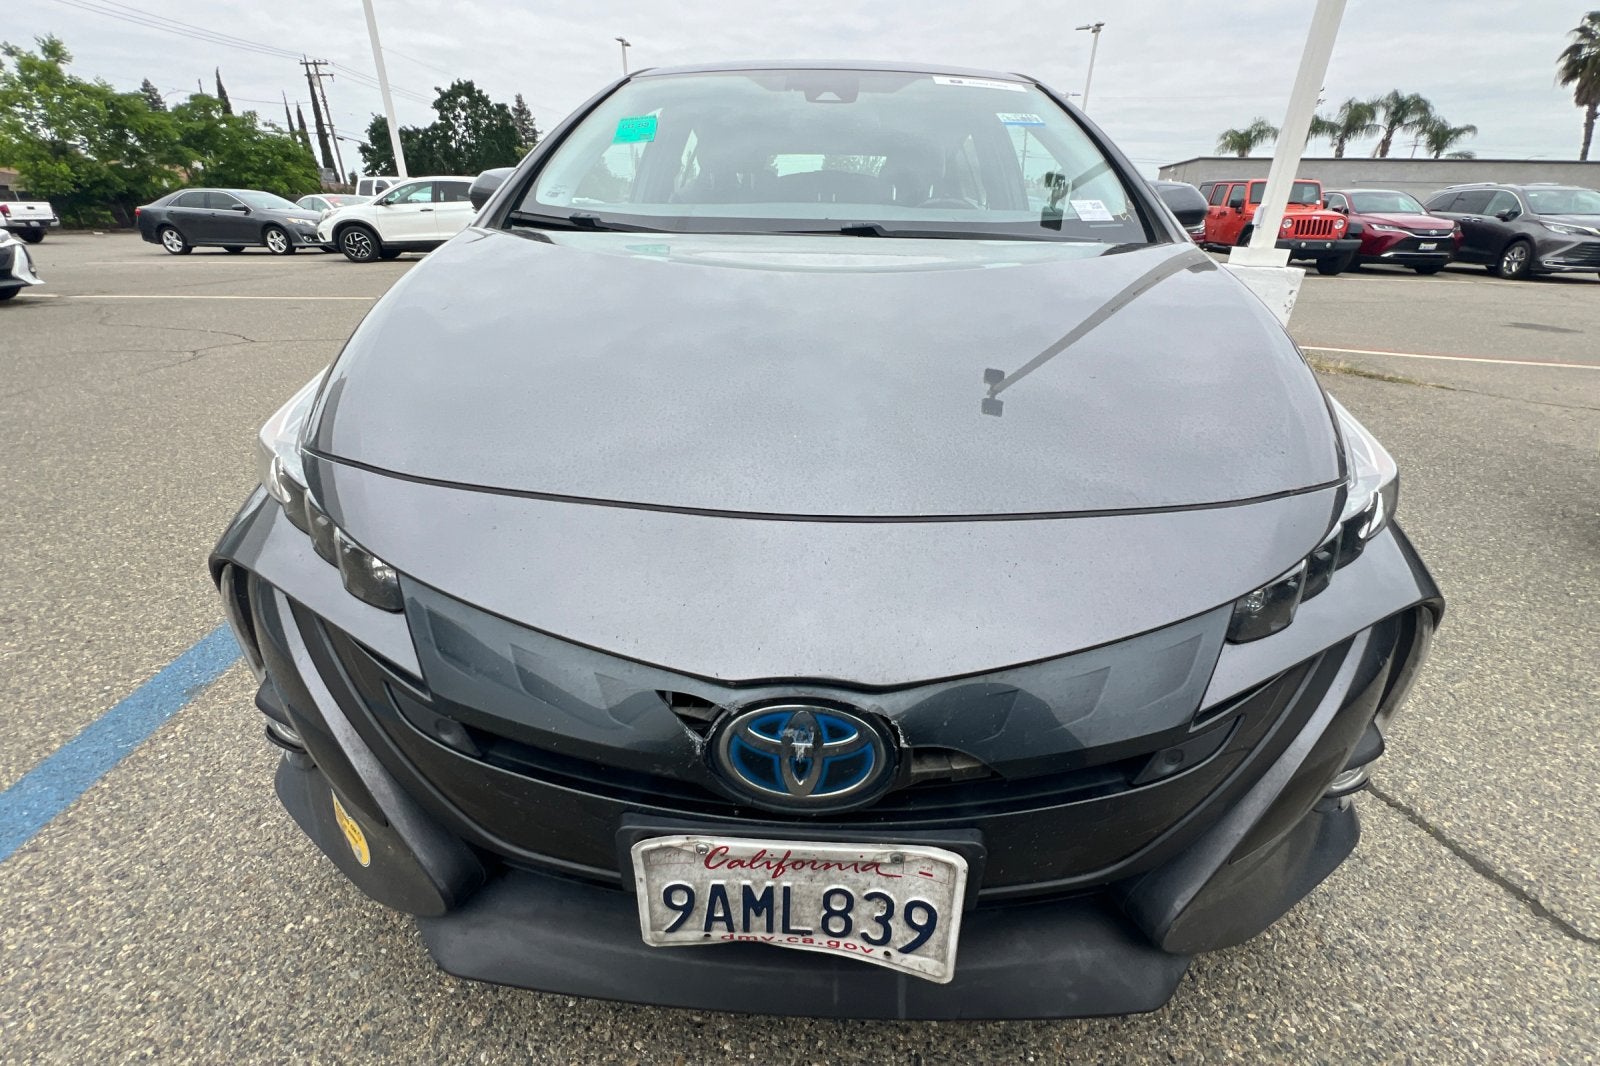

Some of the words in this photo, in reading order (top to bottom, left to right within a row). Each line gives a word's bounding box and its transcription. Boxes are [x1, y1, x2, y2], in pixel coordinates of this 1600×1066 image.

[704, 846, 902, 878] California
[662, 883, 938, 953] 9AML839
[720, 933, 874, 954] dmv.ca.gov
